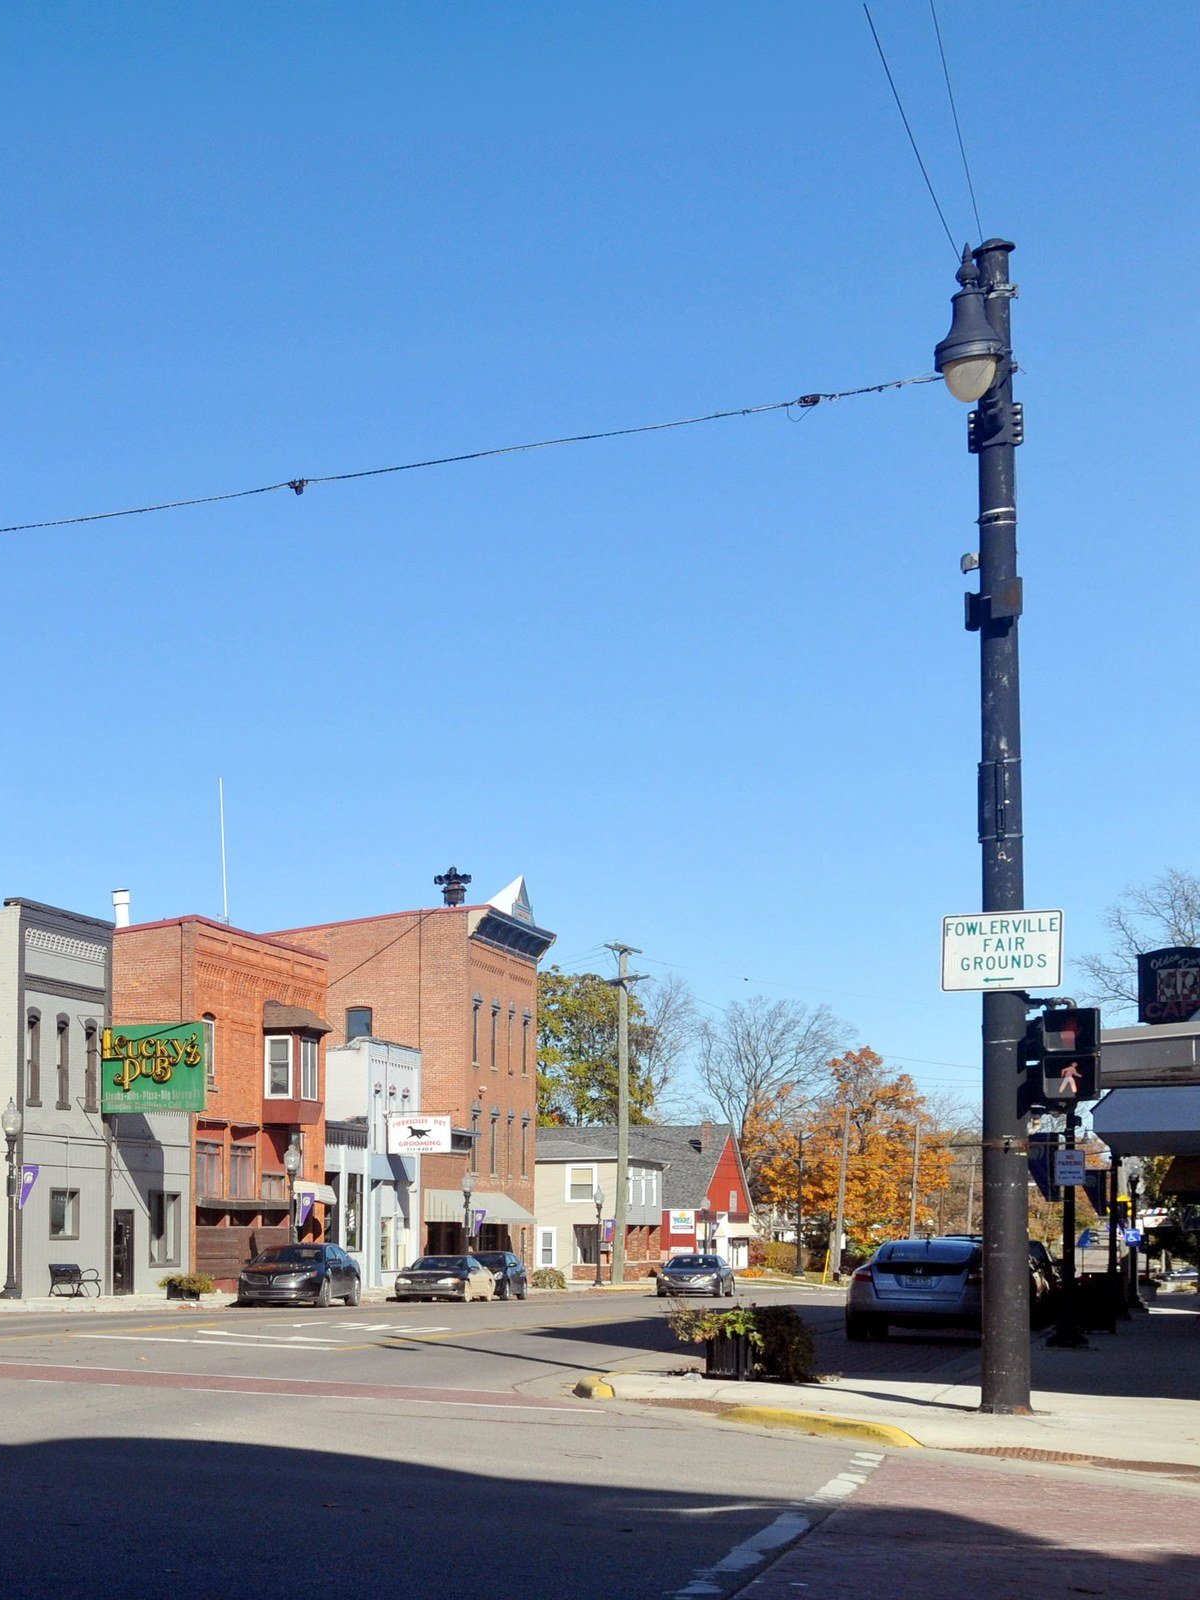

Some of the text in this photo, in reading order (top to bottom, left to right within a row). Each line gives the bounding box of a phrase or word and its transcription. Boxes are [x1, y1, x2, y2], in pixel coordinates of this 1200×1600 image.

[945, 917, 1059, 937] FOWLERVILLE
[983, 936, 1025, 952] FAIR
[960, 953, 1047, 971] GROUNDS
[113, 1057, 173, 1092] PUB
[392, 1118, 446, 1128] PRECIOUS PET
